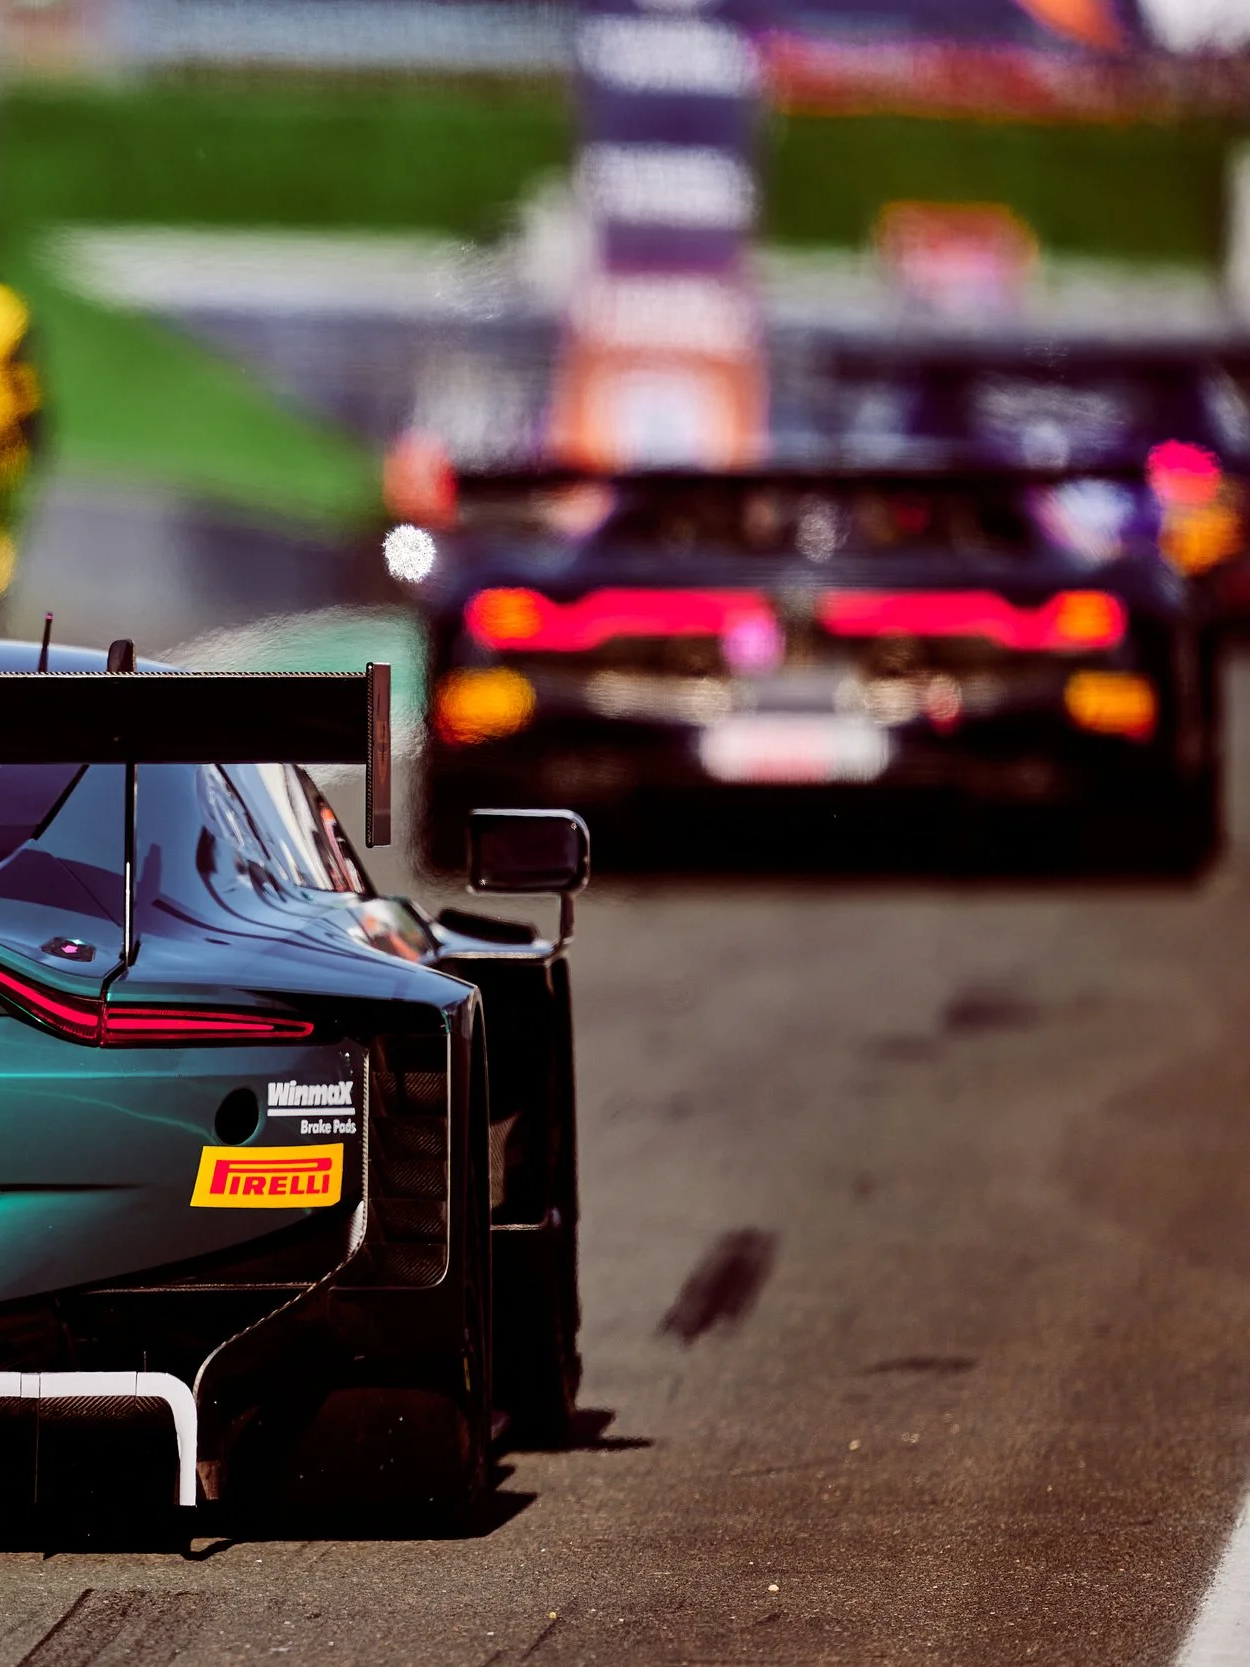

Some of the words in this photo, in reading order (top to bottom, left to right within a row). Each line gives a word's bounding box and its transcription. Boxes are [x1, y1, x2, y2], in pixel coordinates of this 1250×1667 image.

[300, 1118, 331, 1134] Brake
[333, 1117, 356, 1134] Pads
[209, 1157, 332, 1195] PIRELLI
